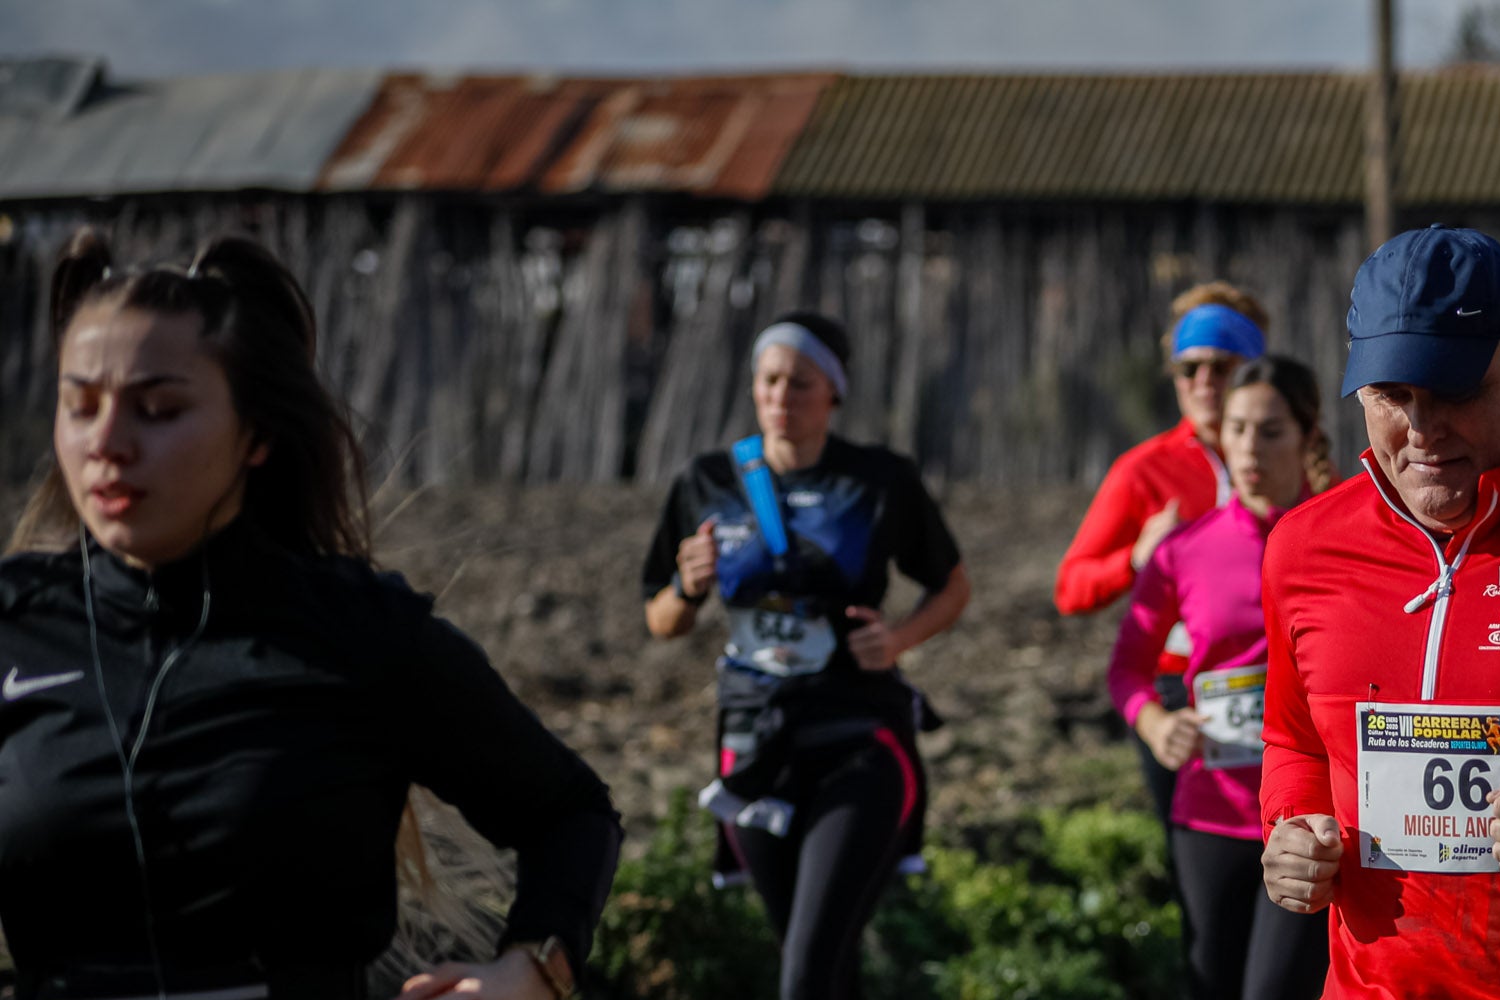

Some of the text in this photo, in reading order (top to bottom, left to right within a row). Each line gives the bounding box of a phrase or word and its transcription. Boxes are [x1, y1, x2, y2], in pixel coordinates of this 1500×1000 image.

[1368, 715, 1386, 730] 26
[1399, 715, 1413, 737] VII
[1413, 715, 1481, 729] CARRERA
[1413, 728, 1482, 739] POPULAR
[1368, 737, 1449, 749] Ruta de los Secaderos
[1423, 757, 1492, 811] 66
[1404, 814, 1460, 837] MIGUEL
